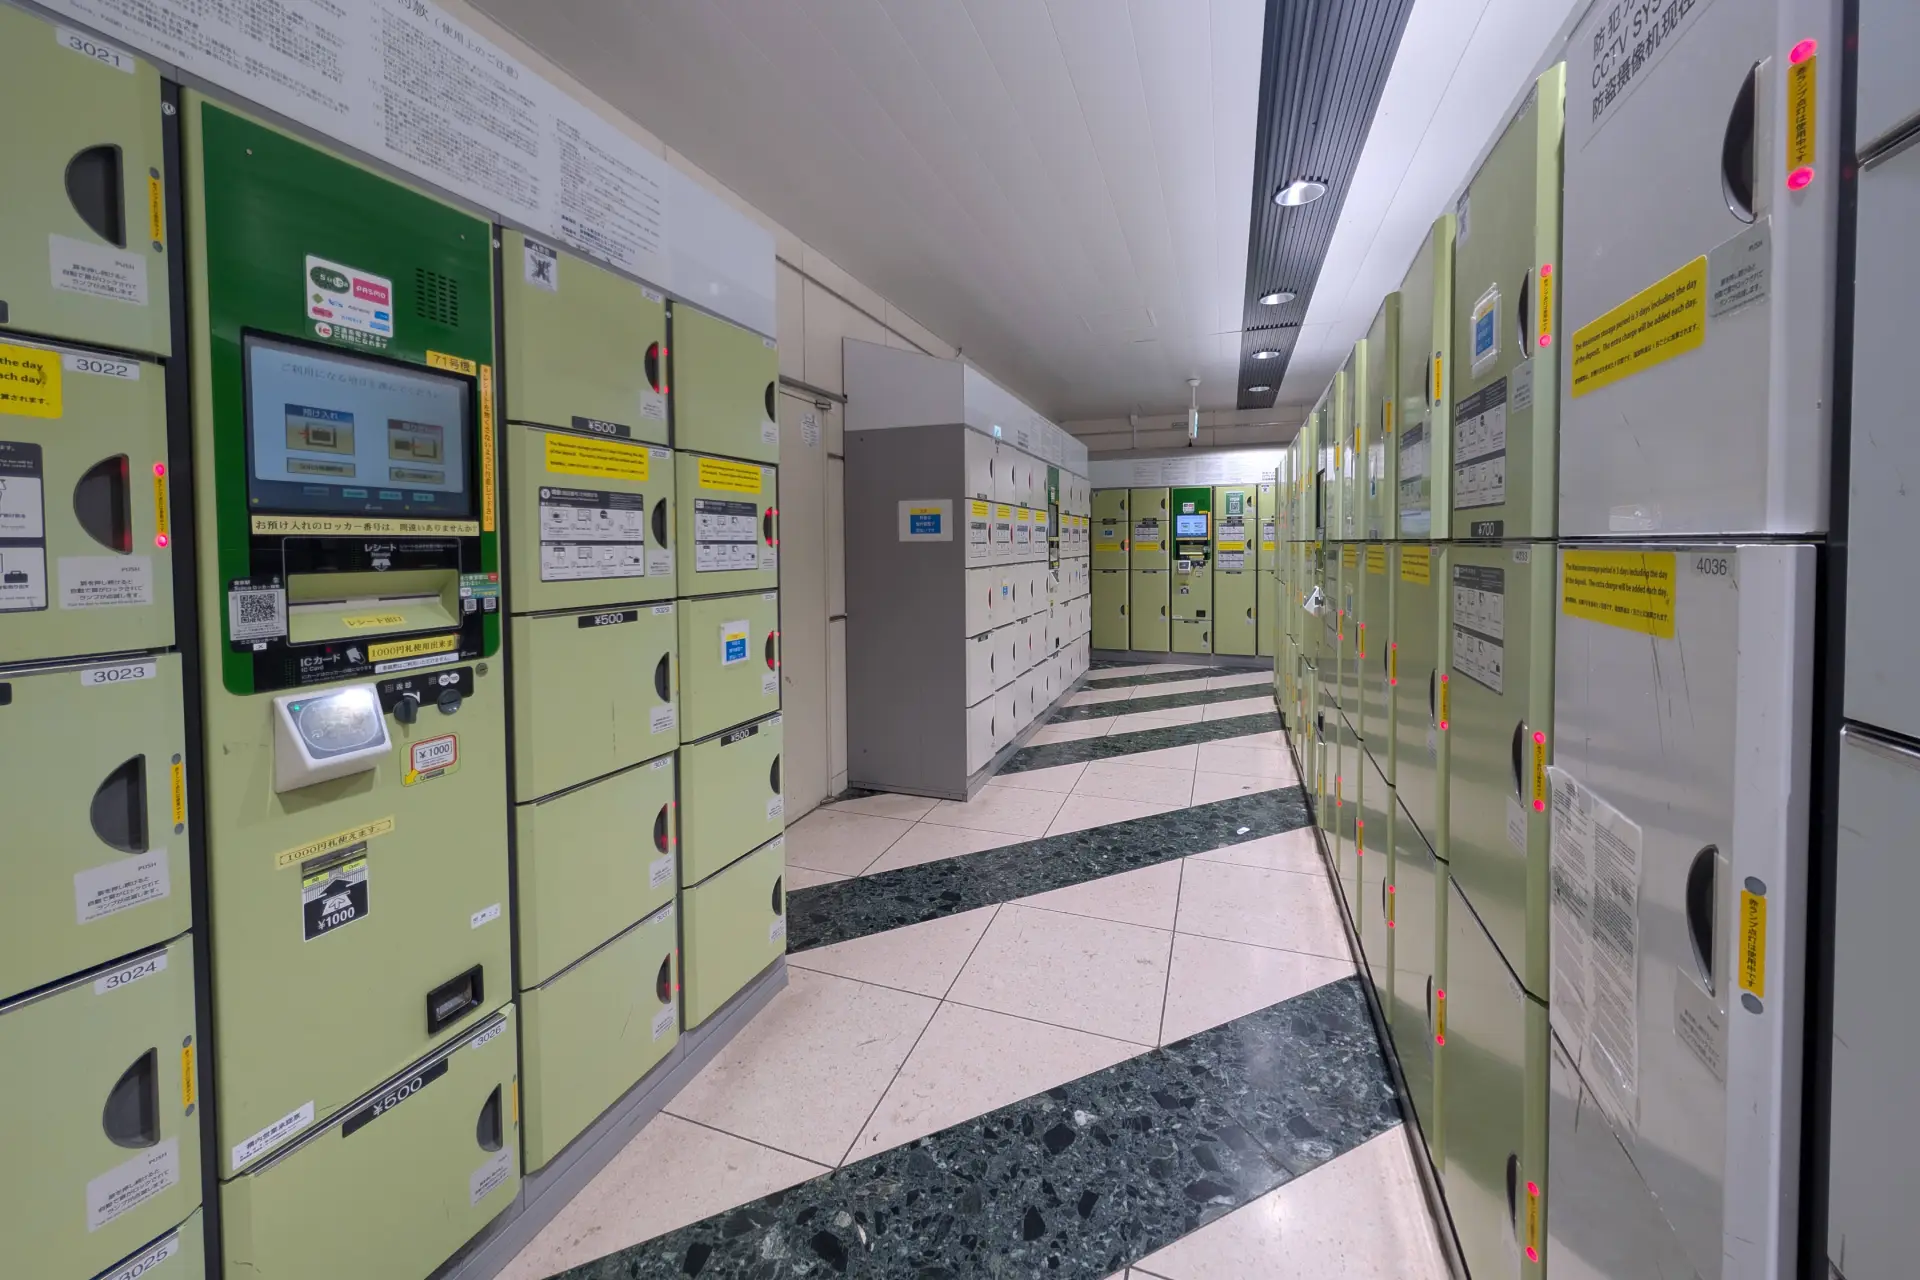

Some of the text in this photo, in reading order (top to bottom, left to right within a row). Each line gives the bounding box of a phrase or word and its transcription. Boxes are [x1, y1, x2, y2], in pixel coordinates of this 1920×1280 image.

[69, 35, 121, 67] 3021
[1592, 25, 1628, 88] CCTV
[356, 285, 386, 299] PASMO
[1651, 291, 1676, 310] including
[1676, 284, 1685, 296] the
[1686, 279, 1697, 291] day
[1621, 329, 1637, 342] charge
[1638, 321, 1647, 333] will
[1654, 308, 1671, 325] added
[1671, 303, 1684, 316] each
[22, 359, 43, 371] day
[76, 358, 128, 377] 3022
[434, 354, 472, 373] 71号機
[302, 407, 339, 420] 預け入れ
[588, 420, 617, 434] ¥500
[1477, 523, 1495, 537] ¥700
[364, 543, 397, 553] レシート
[1658, 570, 1668, 580] day
[1696, 557, 1728, 576] 4036
[595, 613, 623, 625] ¥500
[300, 653, 341, 668] ICカード
[94, 666, 145, 683] 3023
[730, 729, 750, 742] ¥500
[318, 906, 356, 931] ¥1000
[106, 960, 157, 990] 3024
[477, 1026, 502, 1046] 3026
[373, 1077, 423, 1116] ¥500
[118, 1249, 168, 1280] 3025
